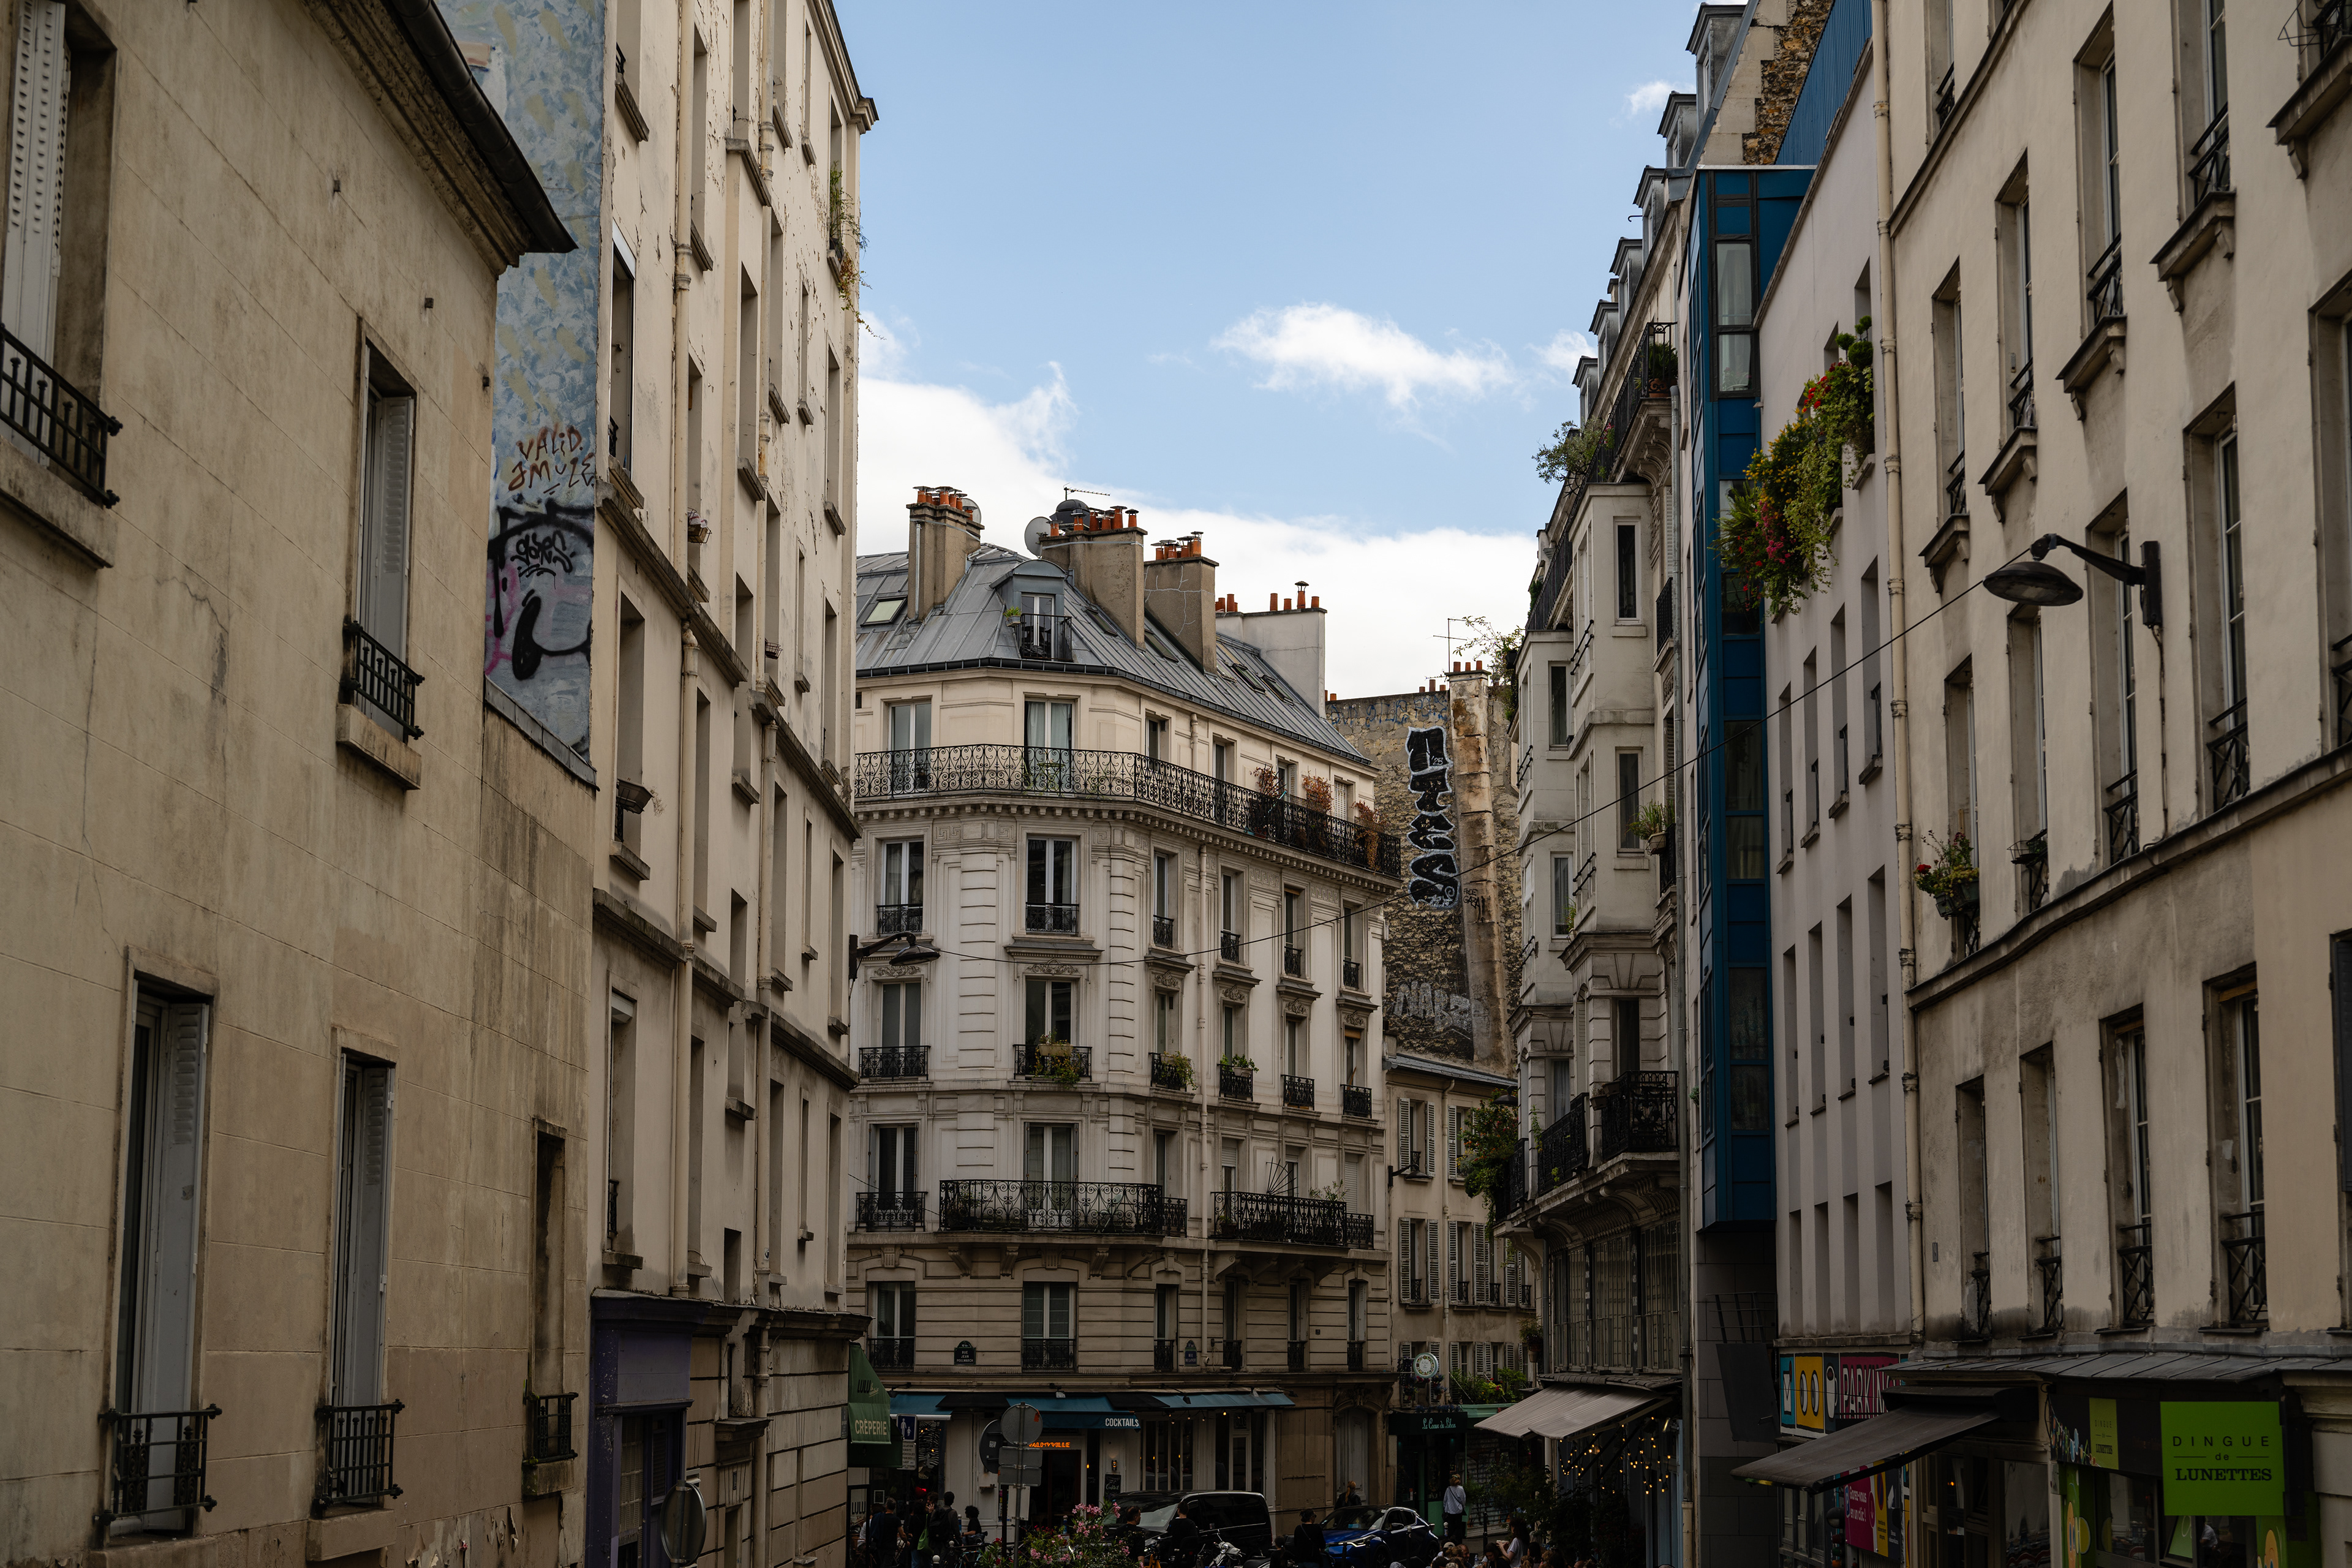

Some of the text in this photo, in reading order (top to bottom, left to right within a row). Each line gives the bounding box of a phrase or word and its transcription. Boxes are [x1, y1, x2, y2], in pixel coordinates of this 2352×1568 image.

[1463, 895, 1480, 913] GAZA
[858, 1379, 871, 1393] LULU
[1842, 1366, 1896, 1419] PARKIN
[854, 1419, 887, 1436] CRÊPERIE
[1105, 1418, 1139, 1427] COCKTAILS
[2095, 1420, 2112, 1428] DINGUE
[2173, 1436, 2269, 1446] DINGUE
[2095, 1444, 2113, 1454] LUNETTES
[2175, 1468, 2272, 1481] LUNETTES
[1849, 1486, 1867, 1503] Garez-vous
[852, 1501, 865, 1515] LULU
[1850, 1508, 1855, 1518] en
[1854, 1509, 1858, 1520] un
